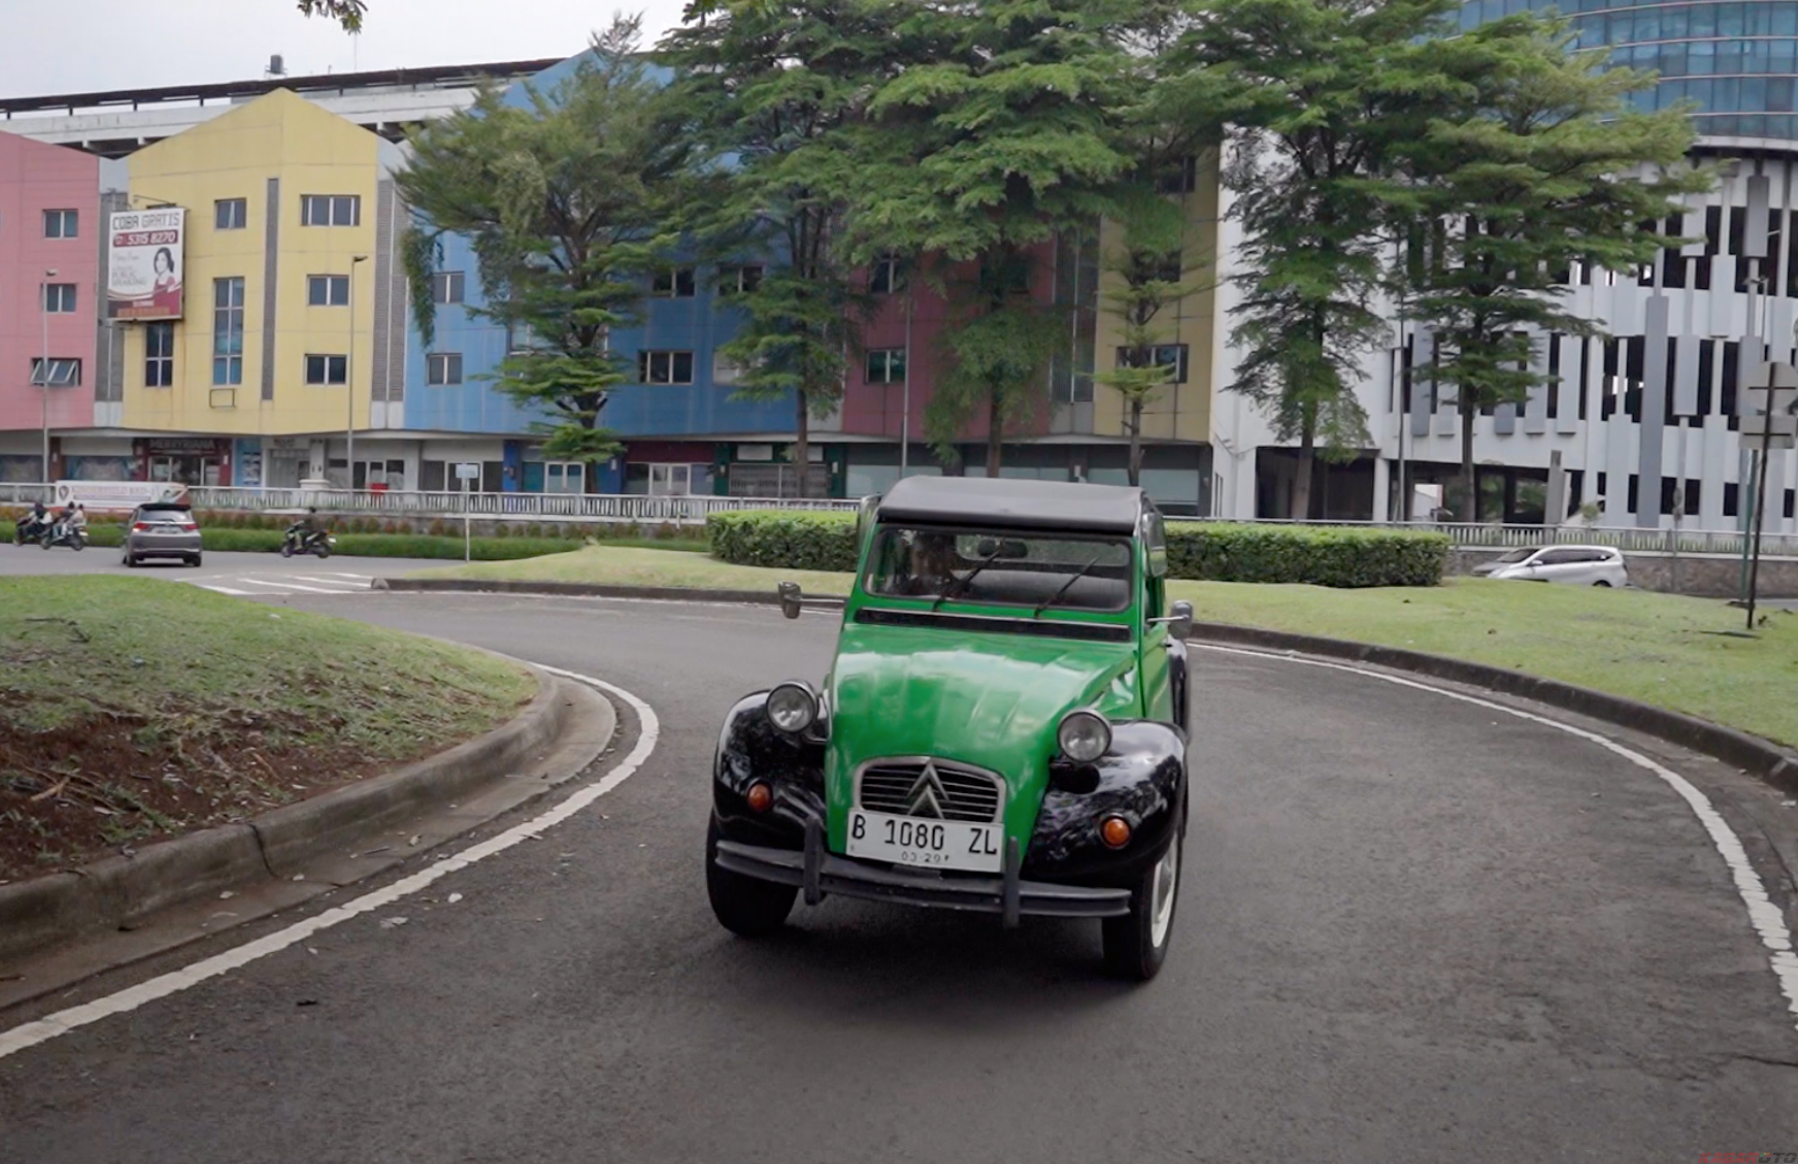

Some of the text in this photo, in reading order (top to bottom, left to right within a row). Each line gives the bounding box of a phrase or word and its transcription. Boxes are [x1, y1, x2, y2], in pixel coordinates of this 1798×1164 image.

[112, 213, 180, 230] COBA GRATIS
[128, 231, 175, 245] 5315 8270
[852, 814, 997, 855] B 1080 ZL
